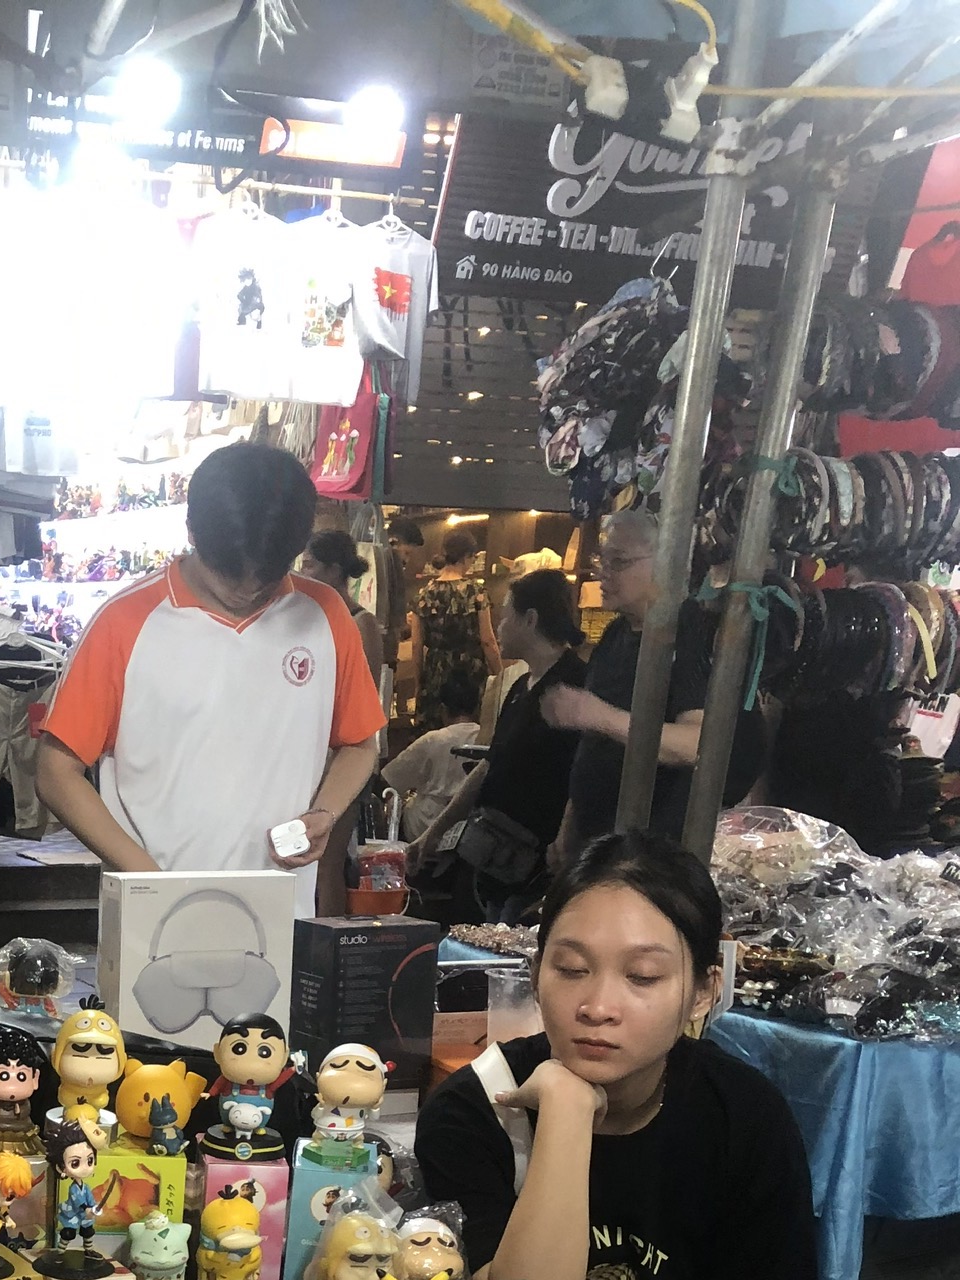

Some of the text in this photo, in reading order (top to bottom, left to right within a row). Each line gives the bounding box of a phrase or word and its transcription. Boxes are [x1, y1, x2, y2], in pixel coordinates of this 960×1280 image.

[464, 209, 547, 247] COFFEE
[559, 220, 598, 251] TEA
[481, 262, 498, 277] 90
[339, 934, 368, 945] studio
